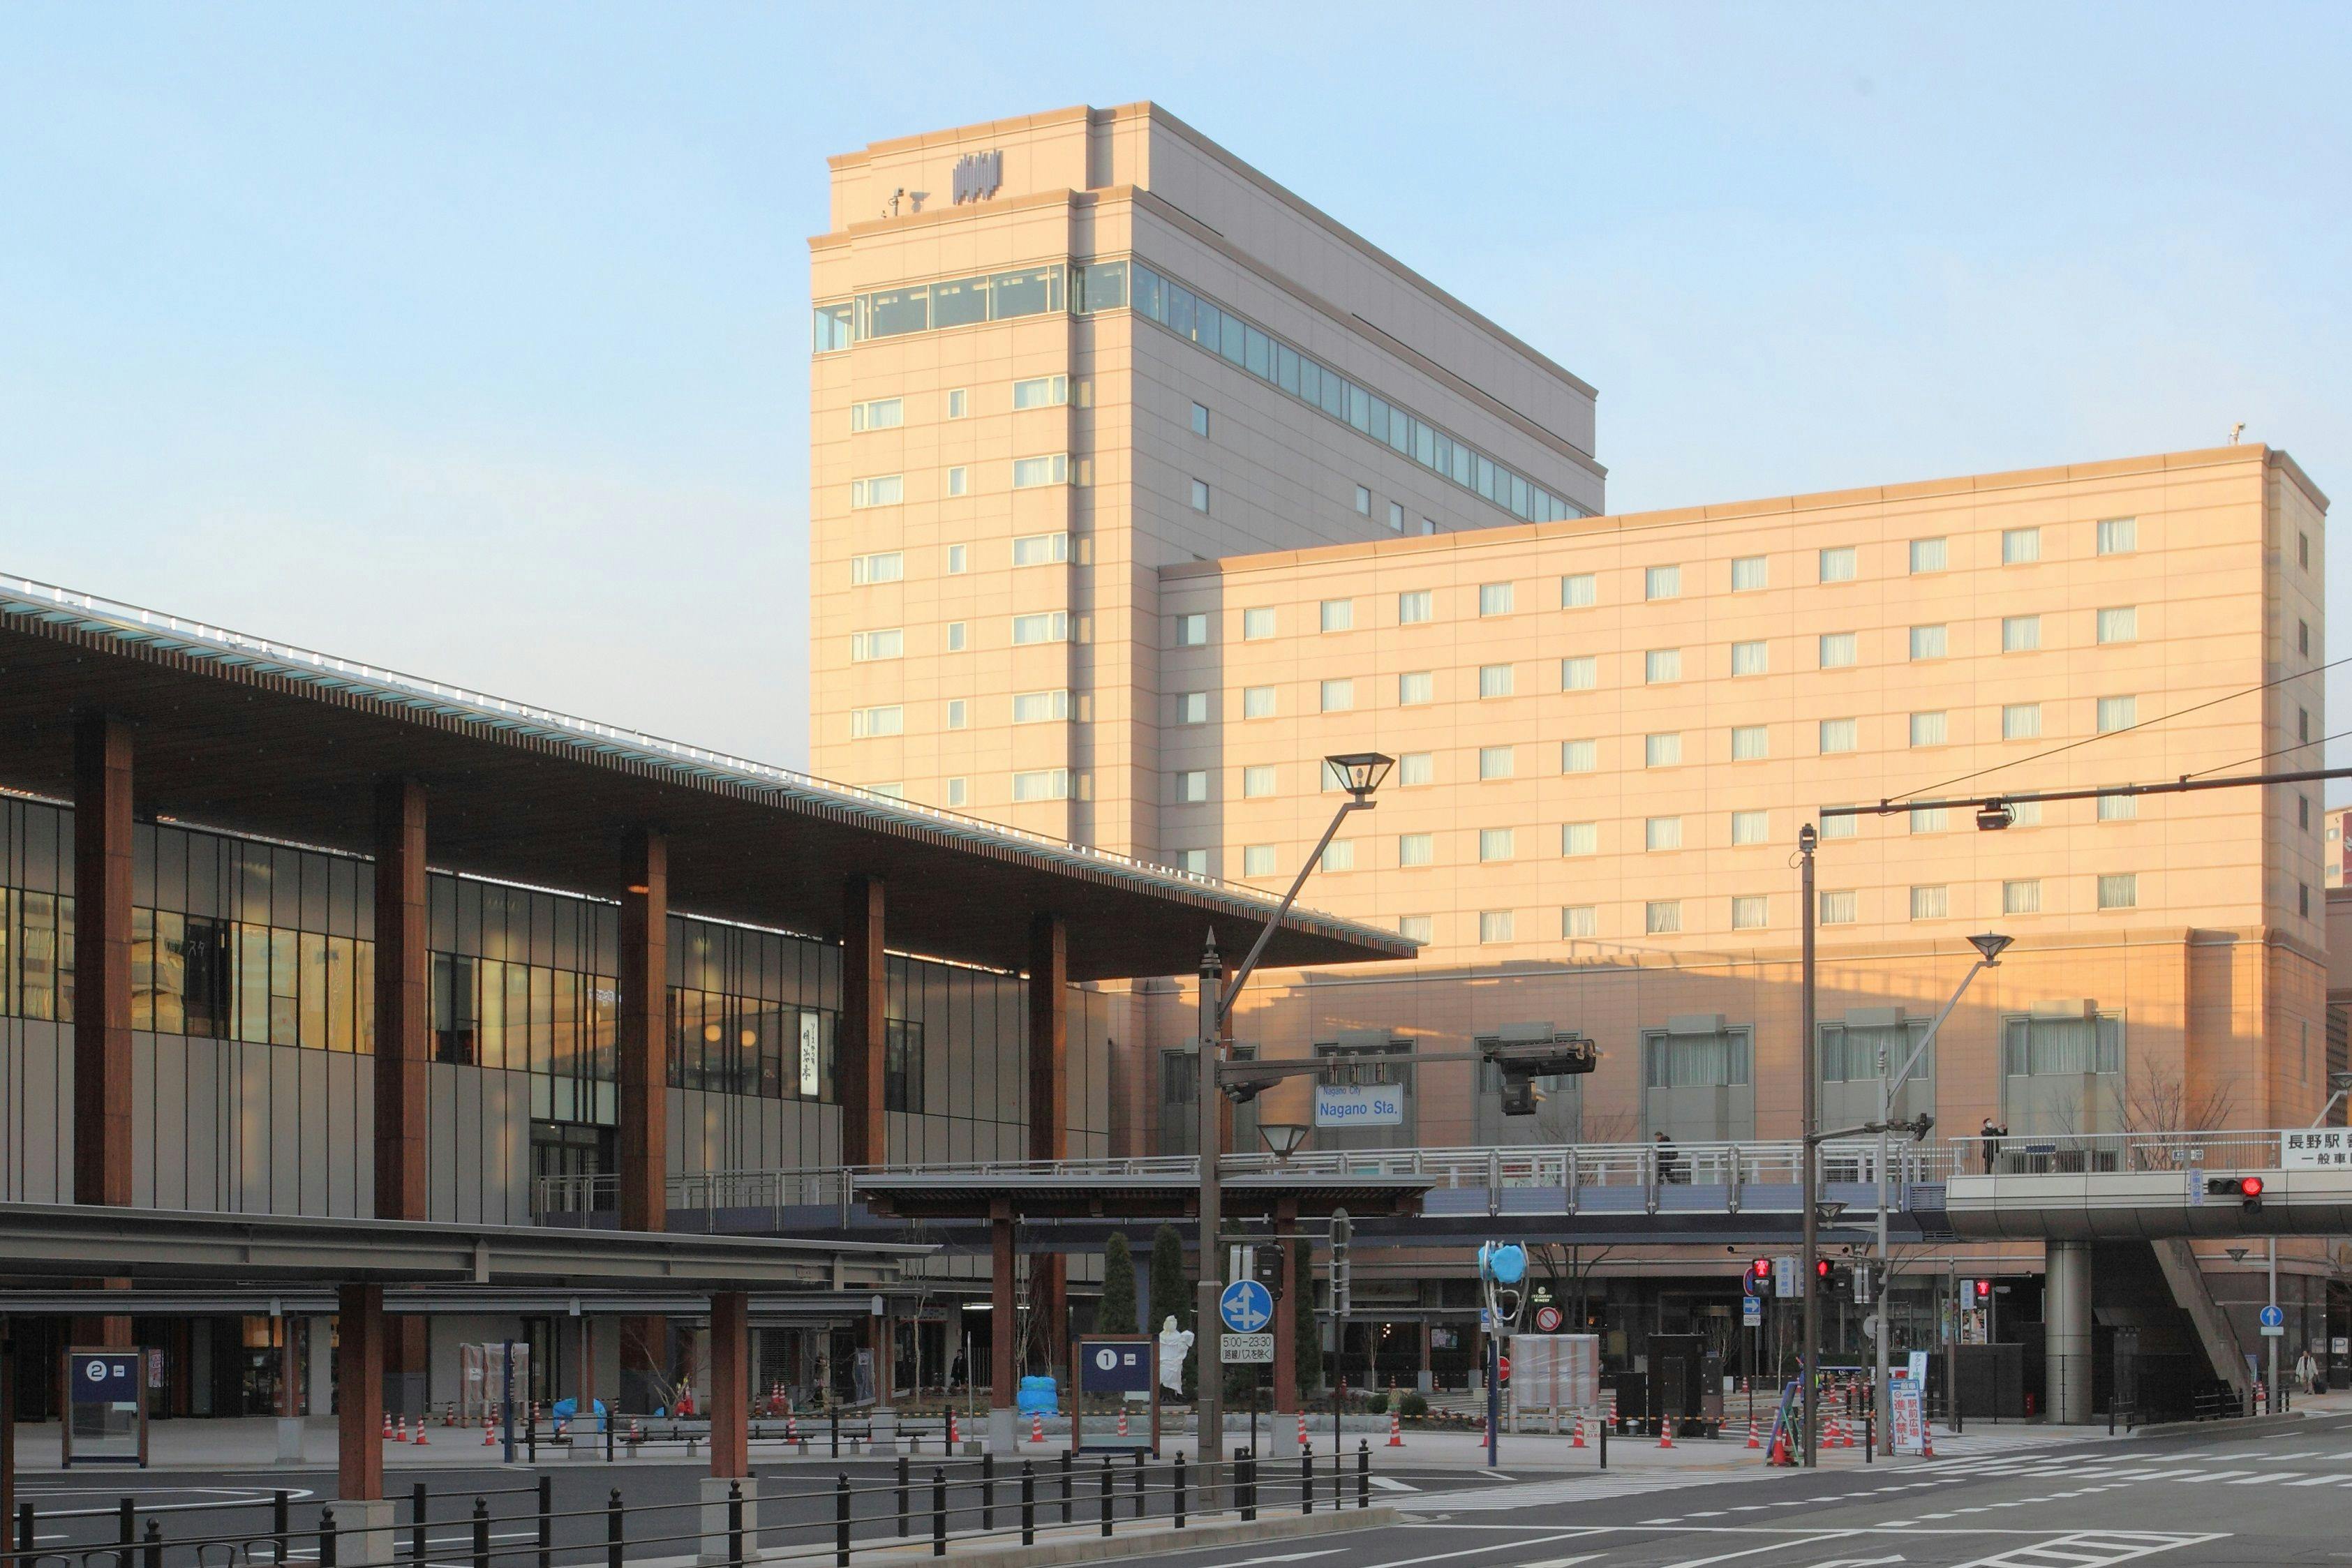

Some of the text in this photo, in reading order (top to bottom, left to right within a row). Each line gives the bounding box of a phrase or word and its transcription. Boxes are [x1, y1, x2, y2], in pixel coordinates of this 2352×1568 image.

[1323, 1085, 1362, 1097] Nagano City
[1320, 1100, 1398, 1118] Nagano Sta.
[2288, 1133, 2340, 1149] 長野駅
[2301, 1152, 2352, 1165] 一般車
[2334, 1338, 2346, 1352] P
[1103, 1353, 1109, 1366] 1
[91, 1364, 103, 1377] 2
[1893, 1399, 1909, 1445] 進入禁止
[1907, 1398, 1919, 1438] 駅前広場
